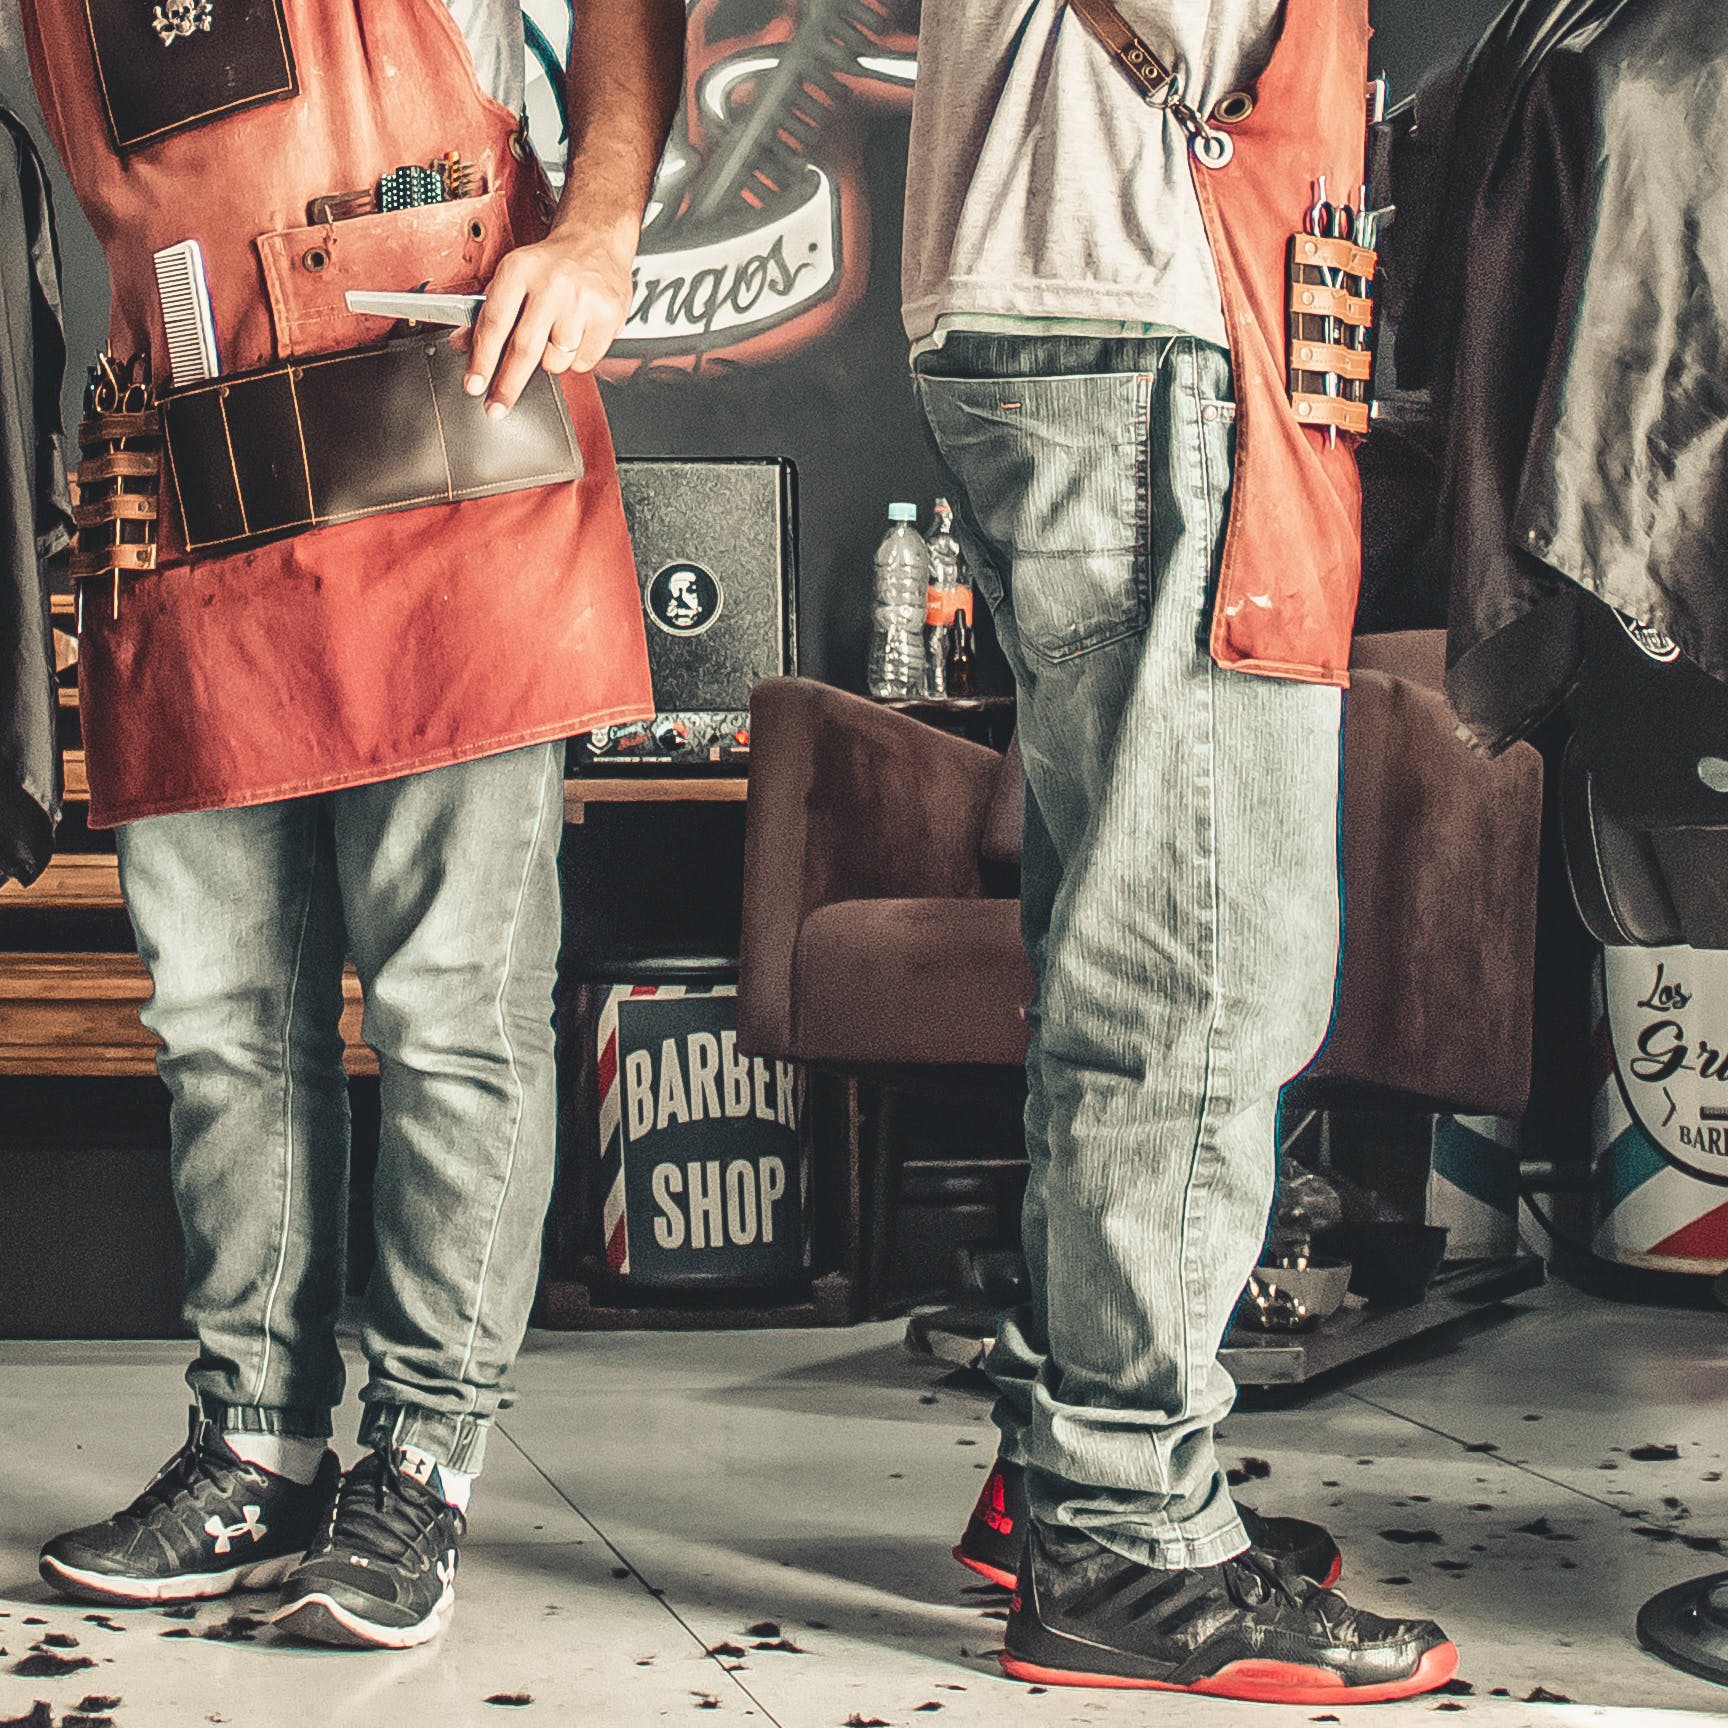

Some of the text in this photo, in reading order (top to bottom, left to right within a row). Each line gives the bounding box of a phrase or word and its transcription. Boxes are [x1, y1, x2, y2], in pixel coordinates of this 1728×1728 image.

[1637, 963, 1692, 1012] Los
[626, 1030, 796, 1142] BARBER
[651, 1156, 786, 1250] SHOP
